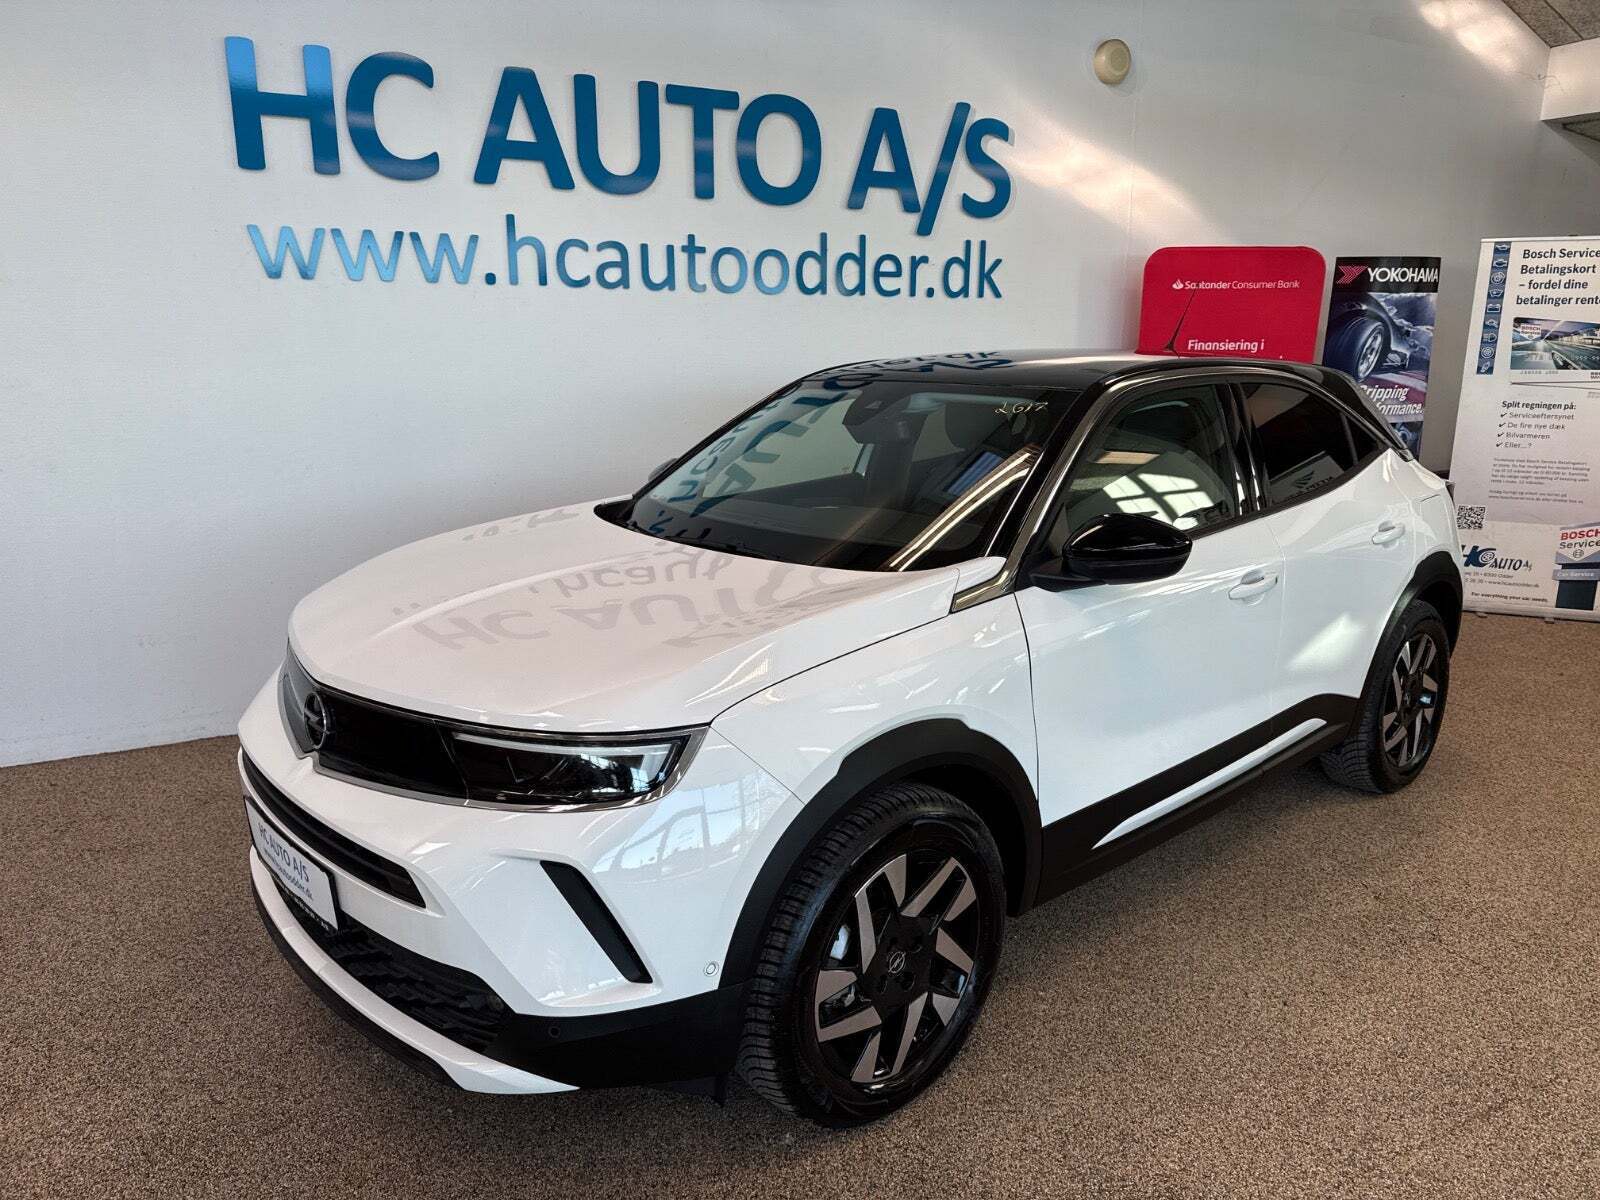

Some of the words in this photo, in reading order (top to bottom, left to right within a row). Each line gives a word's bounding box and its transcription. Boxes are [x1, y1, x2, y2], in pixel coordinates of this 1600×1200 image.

[224, 36, 440, 181] HC
[473, 66, 822, 206] AUTO
[847, 101, 1014, 236] A/S
[246, 213, 1003, 299] www.hcautoodder.dk
[1522, 248, 1556, 259] Bosch
[1559, 247, 1600, 258] Service
[1367, 267, 1438, 283] YOKOHAMA
[1520, 263, 1597, 276] Betalingskort
[1231, 280, 1276, 289] Consumer
[1276, 279, 1300, 288] Bank
[1528, 279, 1561, 290] fordel
[1563, 279, 1589, 290] dine
[1515, 294, 1572, 307] betalinger
[1187, 339, 1258, 353] Finansiering
[1260, 339, 1265, 350] i
[1501, 400, 1521, 410] Split
[1521, 401, 1562, 411] regningen
[1563, 401, 1577, 411] på:
[1508, 412, 1575, 421] Serviceeftersynet
[1507, 421, 1518, 429] De
[1520, 421, 1533, 429] fire
[1534, 423, 1548, 431] nye
[1505, 431, 1551, 440] Bilvarmeren
[1489, 557, 1524, 571] AUTO
